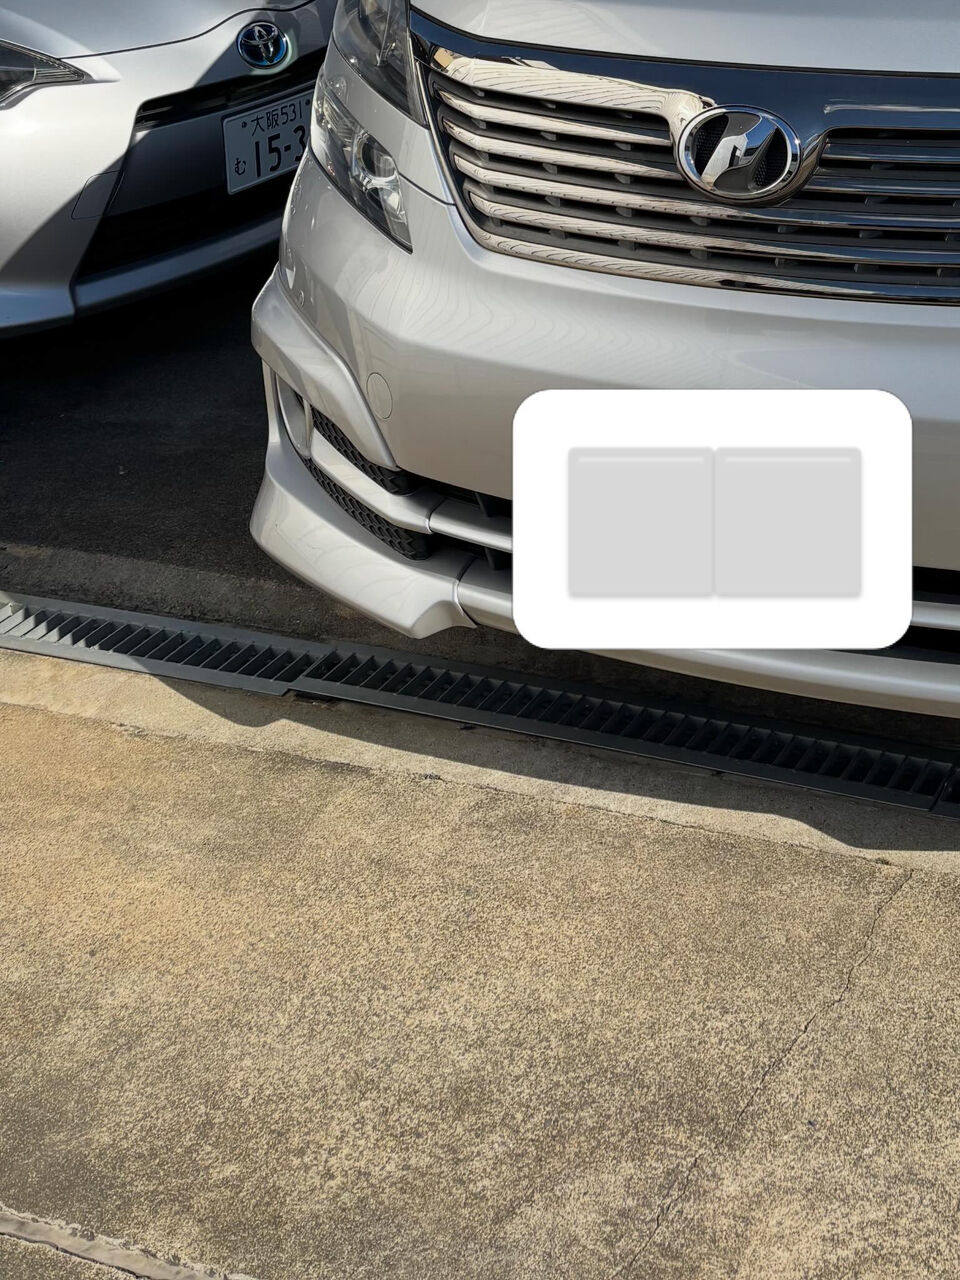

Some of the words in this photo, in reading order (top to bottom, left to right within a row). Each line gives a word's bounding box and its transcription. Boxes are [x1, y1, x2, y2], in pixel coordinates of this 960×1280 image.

[251, 100, 302, 136] 大阪531
[235, 158, 246, 175] む
[255, 125, 306, 177] 15-3
